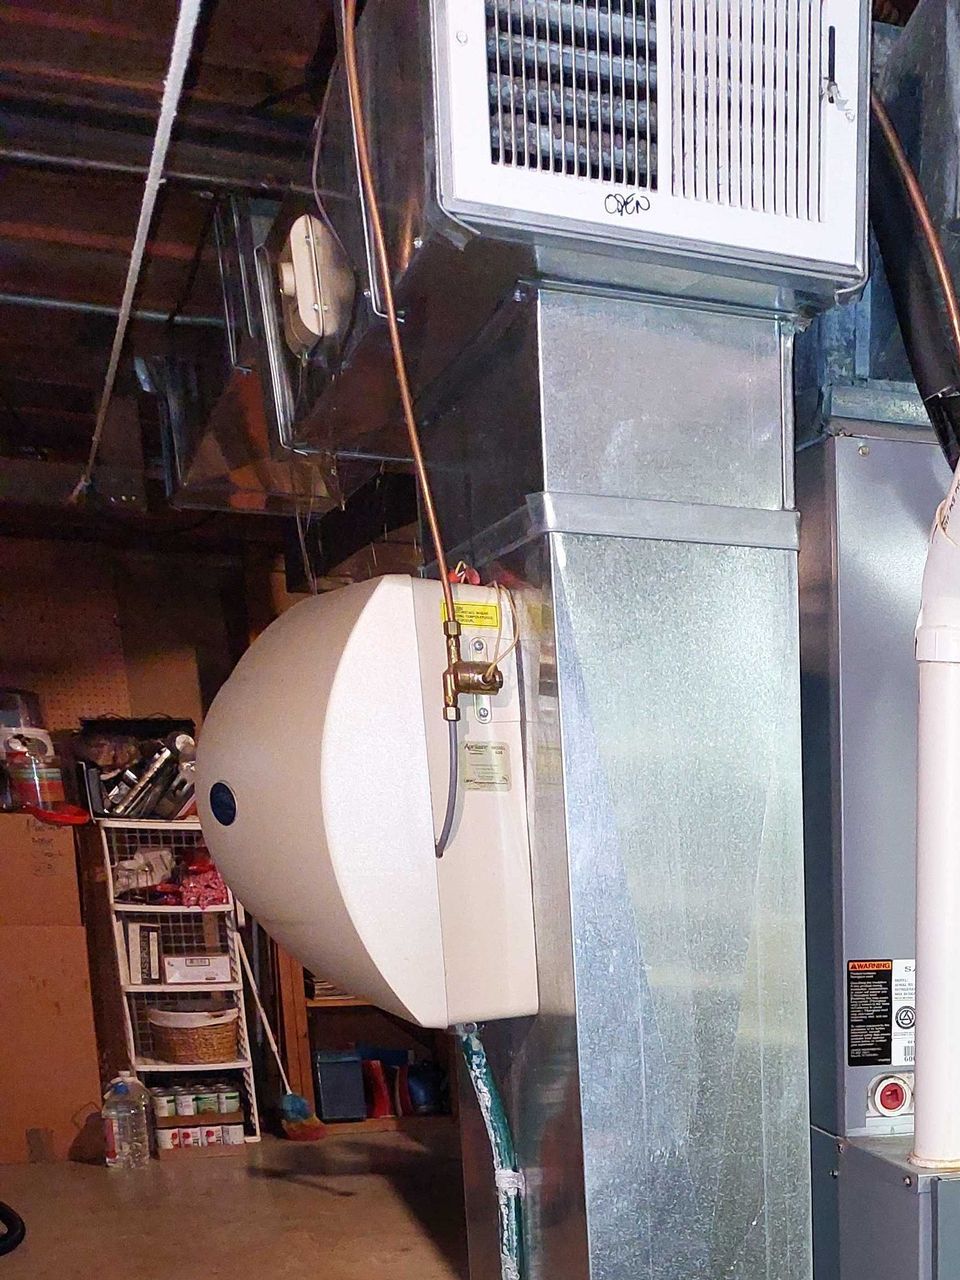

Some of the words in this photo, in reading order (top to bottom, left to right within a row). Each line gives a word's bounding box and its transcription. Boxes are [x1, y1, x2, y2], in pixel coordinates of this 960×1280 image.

[604, 193, 651, 218] OPEN
[140, 931, 150, 979] PASSPORTS
[856, 962, 891, 970] WARNING
